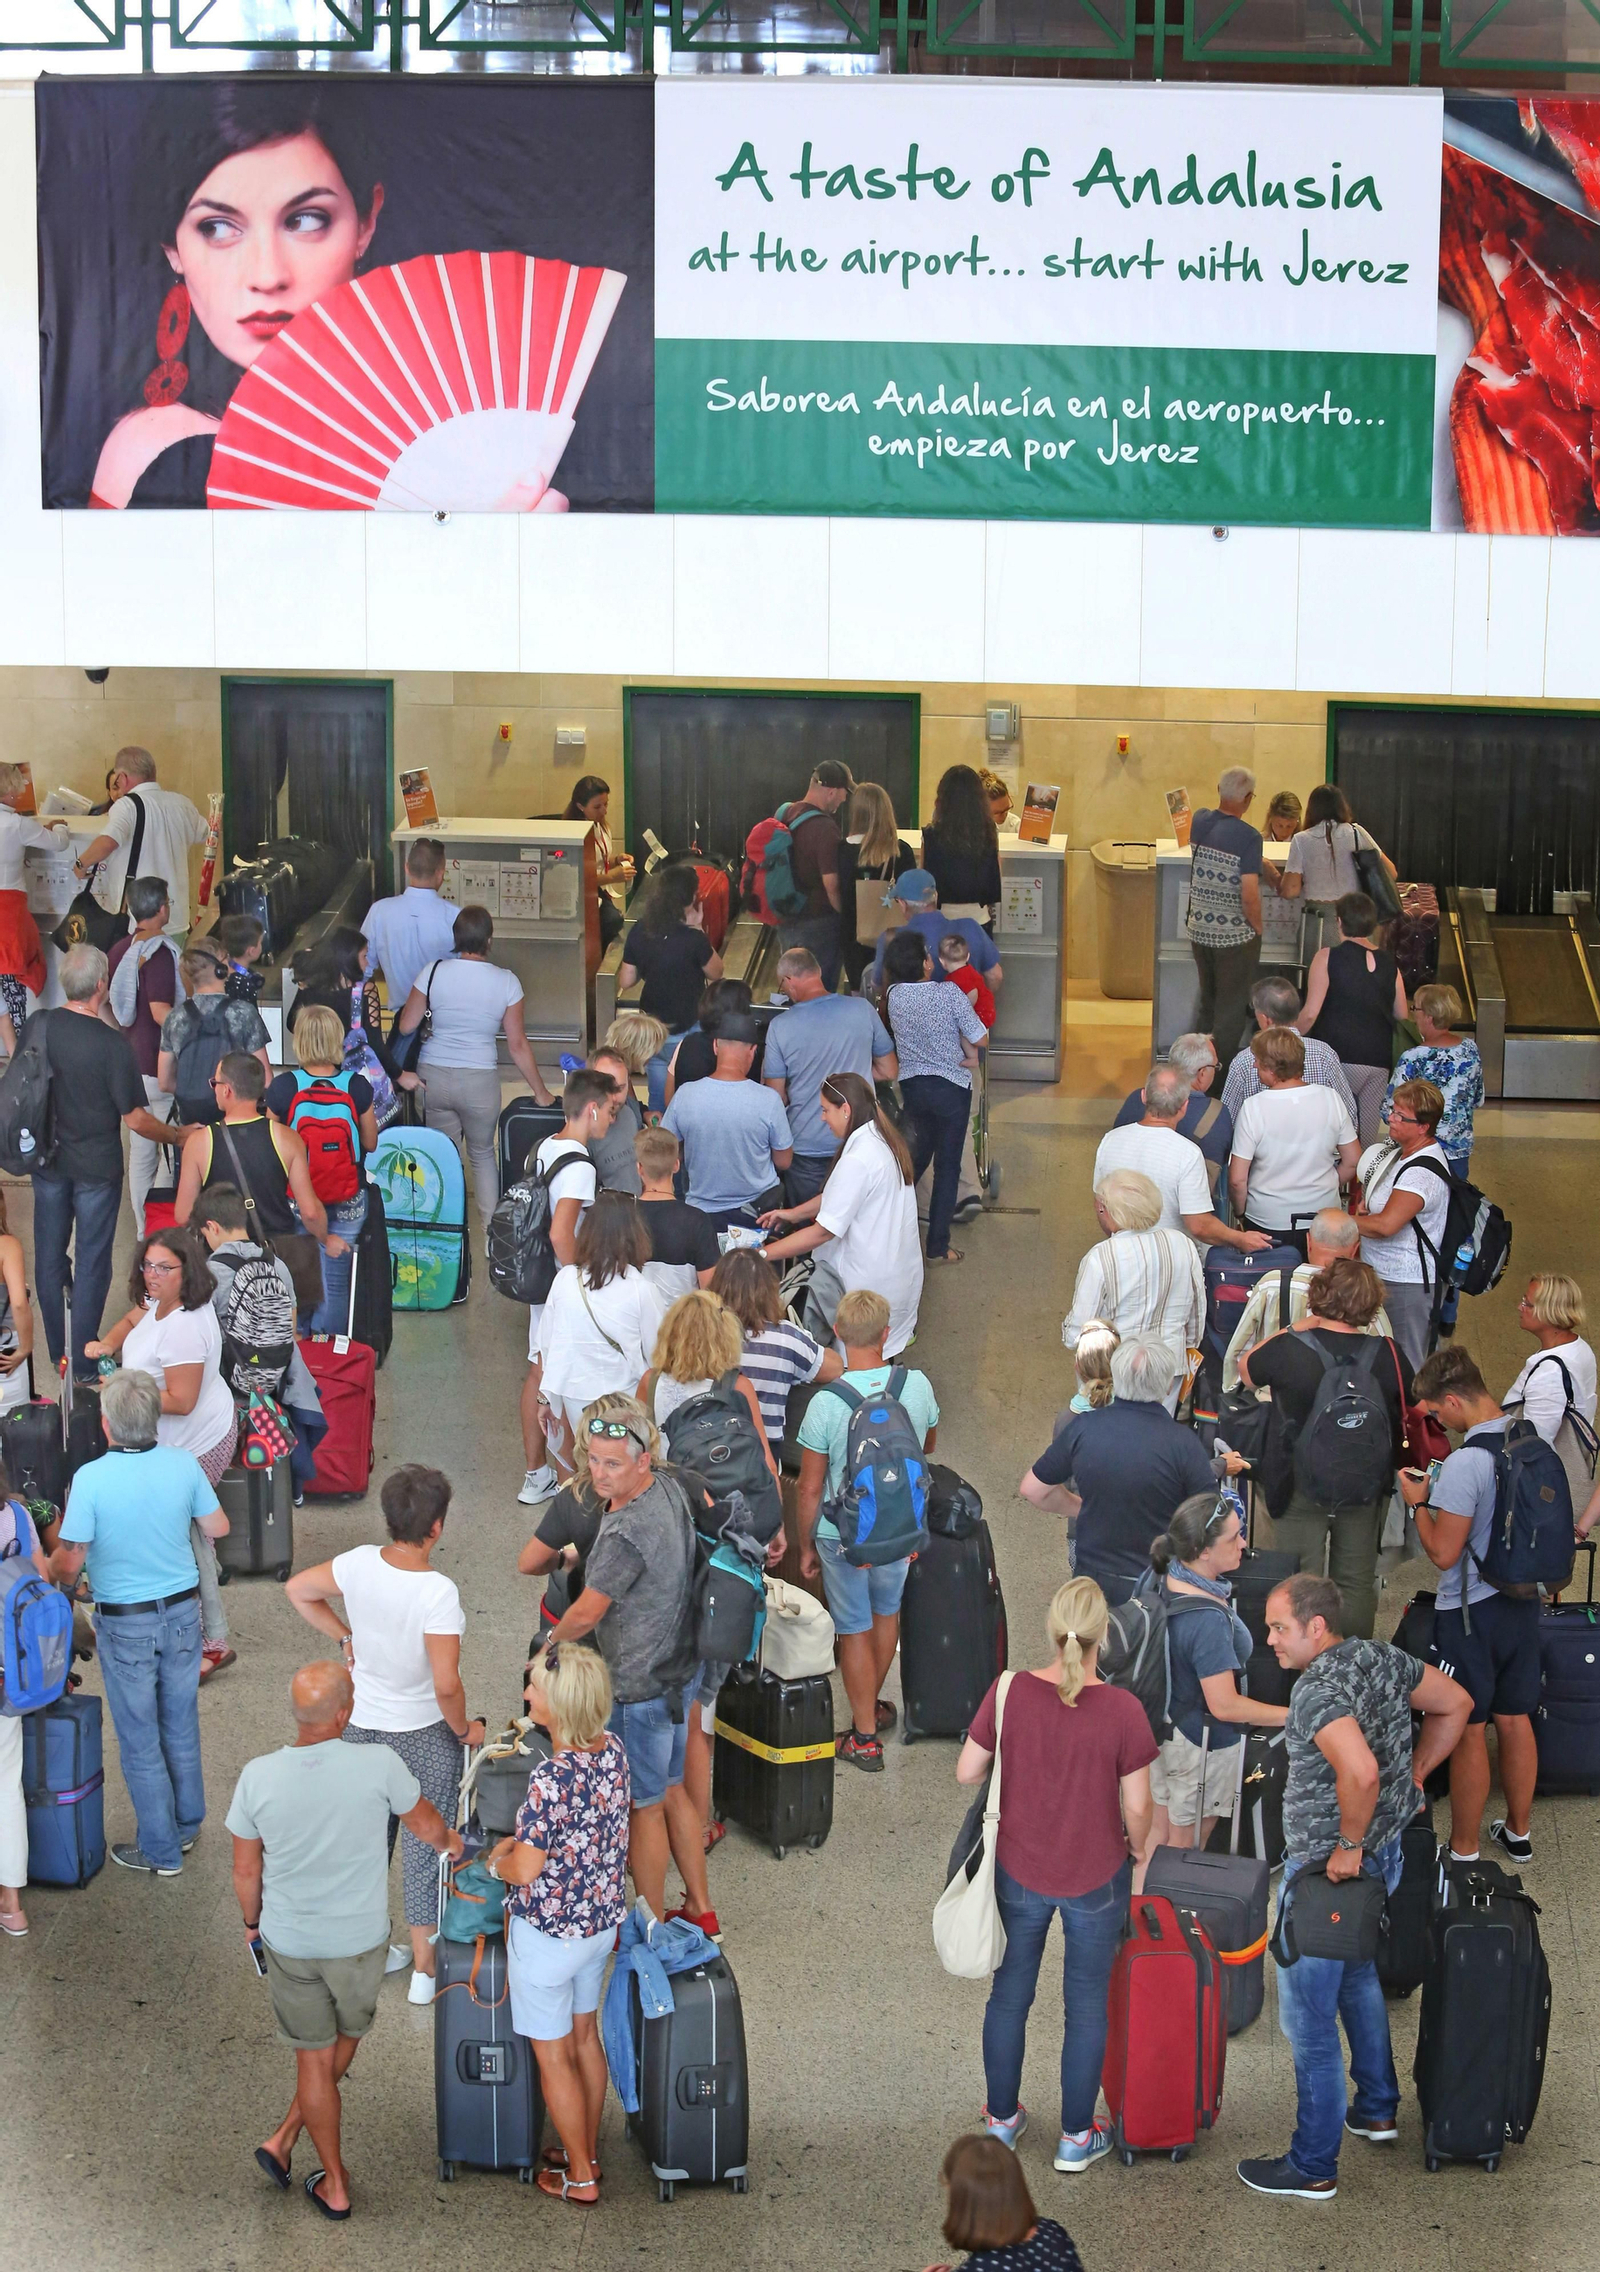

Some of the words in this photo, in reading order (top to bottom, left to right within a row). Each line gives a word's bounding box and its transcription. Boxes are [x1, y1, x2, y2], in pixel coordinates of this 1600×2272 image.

[715, 141, 773, 202] A
[790, 141, 972, 200] taste
[991, 147, 1051, 207] of
[1073, 147, 1383, 212] Andalusia
[688, 231, 740, 273] at
[749, 231, 827, 272] the
[841, 235, 1025, 289] airport...
[1044, 237, 1165, 279] start
[1178, 240, 1263, 283] with
[1283, 228, 1410, 286] Jerez
[706, 376, 861, 415] Saborea
[873, 380, 1055, 418] Andalucía
[1068, 396, 1108, 419] en
[1122, 386, 1151, 420] el
[1164, 391, 1385, 434] aeropuerto...
[869, 428, 1012, 469] empieza
[1024, 439, 1077, 472] por
[1097, 418, 1203, 466] Jerez
